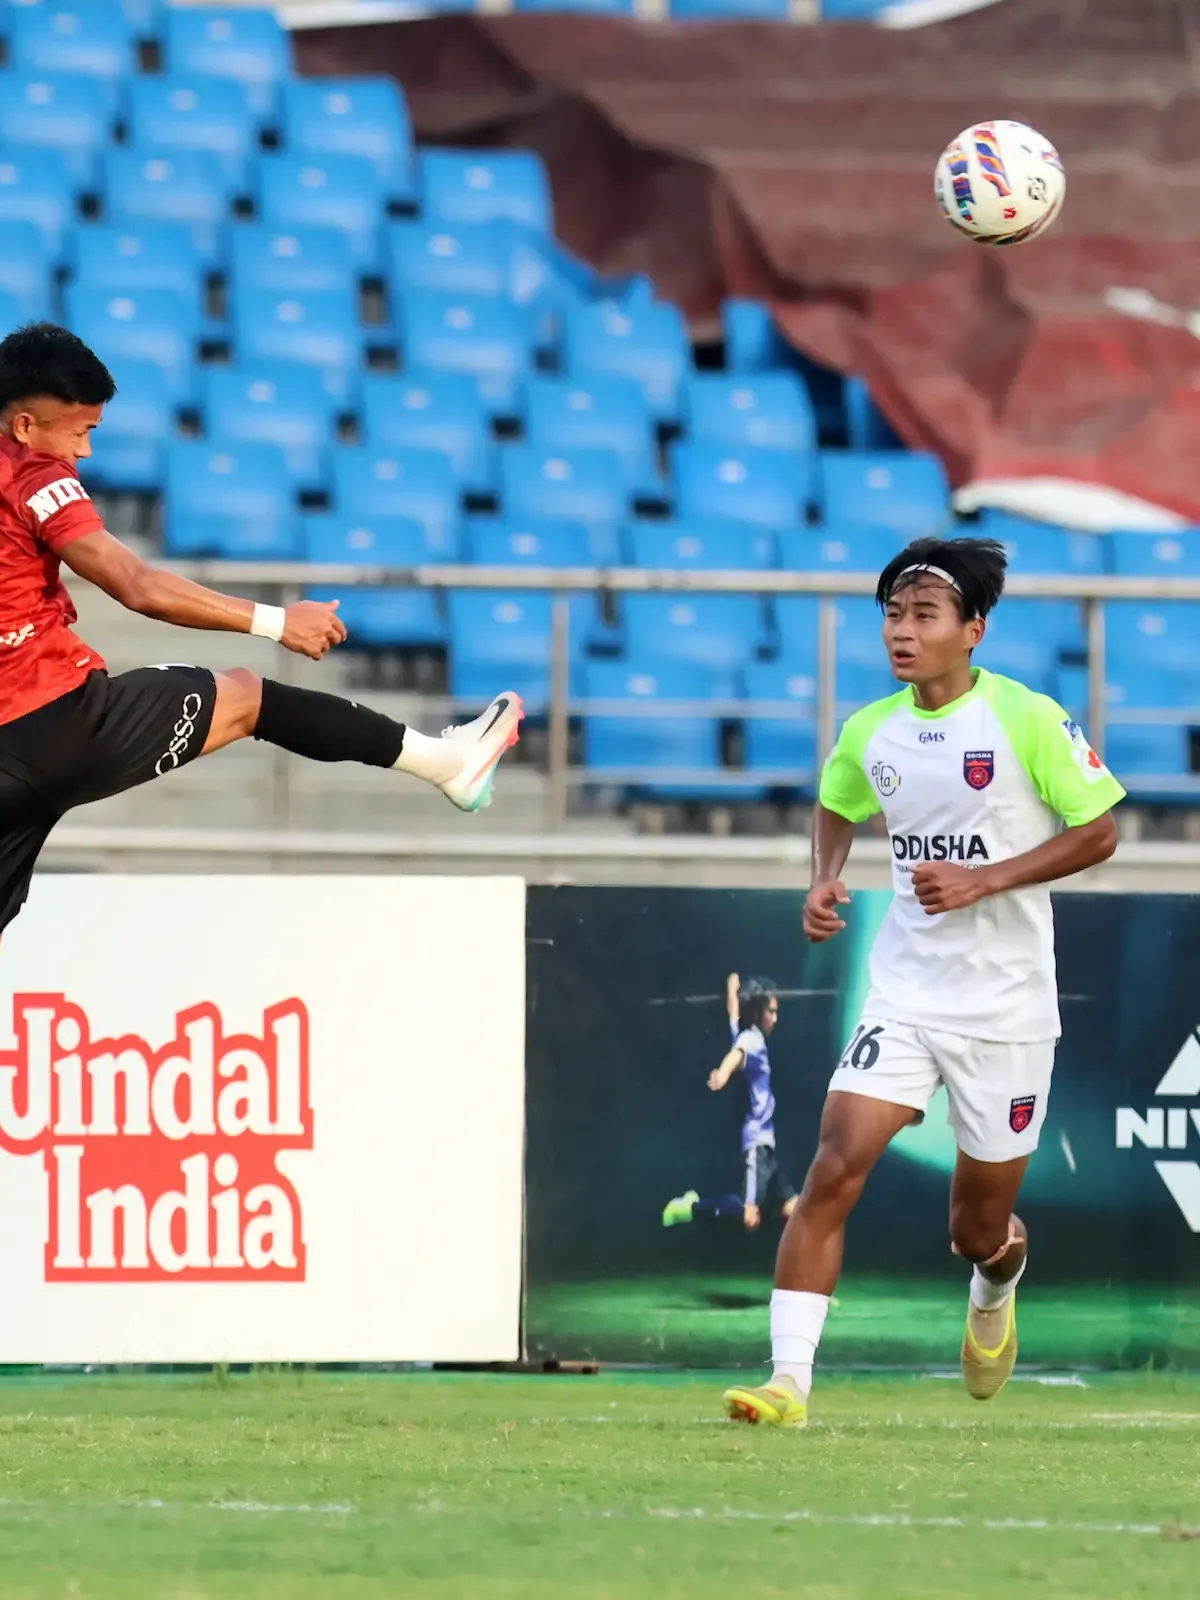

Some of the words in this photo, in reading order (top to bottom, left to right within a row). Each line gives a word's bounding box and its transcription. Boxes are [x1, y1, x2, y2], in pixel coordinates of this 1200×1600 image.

[918, 731, 946, 744] GMS
[891, 834, 990, 861] ODISHA
[837, 1024, 886, 1070] 26
[1116, 1107, 1200, 1149] NI
[52, 1144, 298, 1273] India
